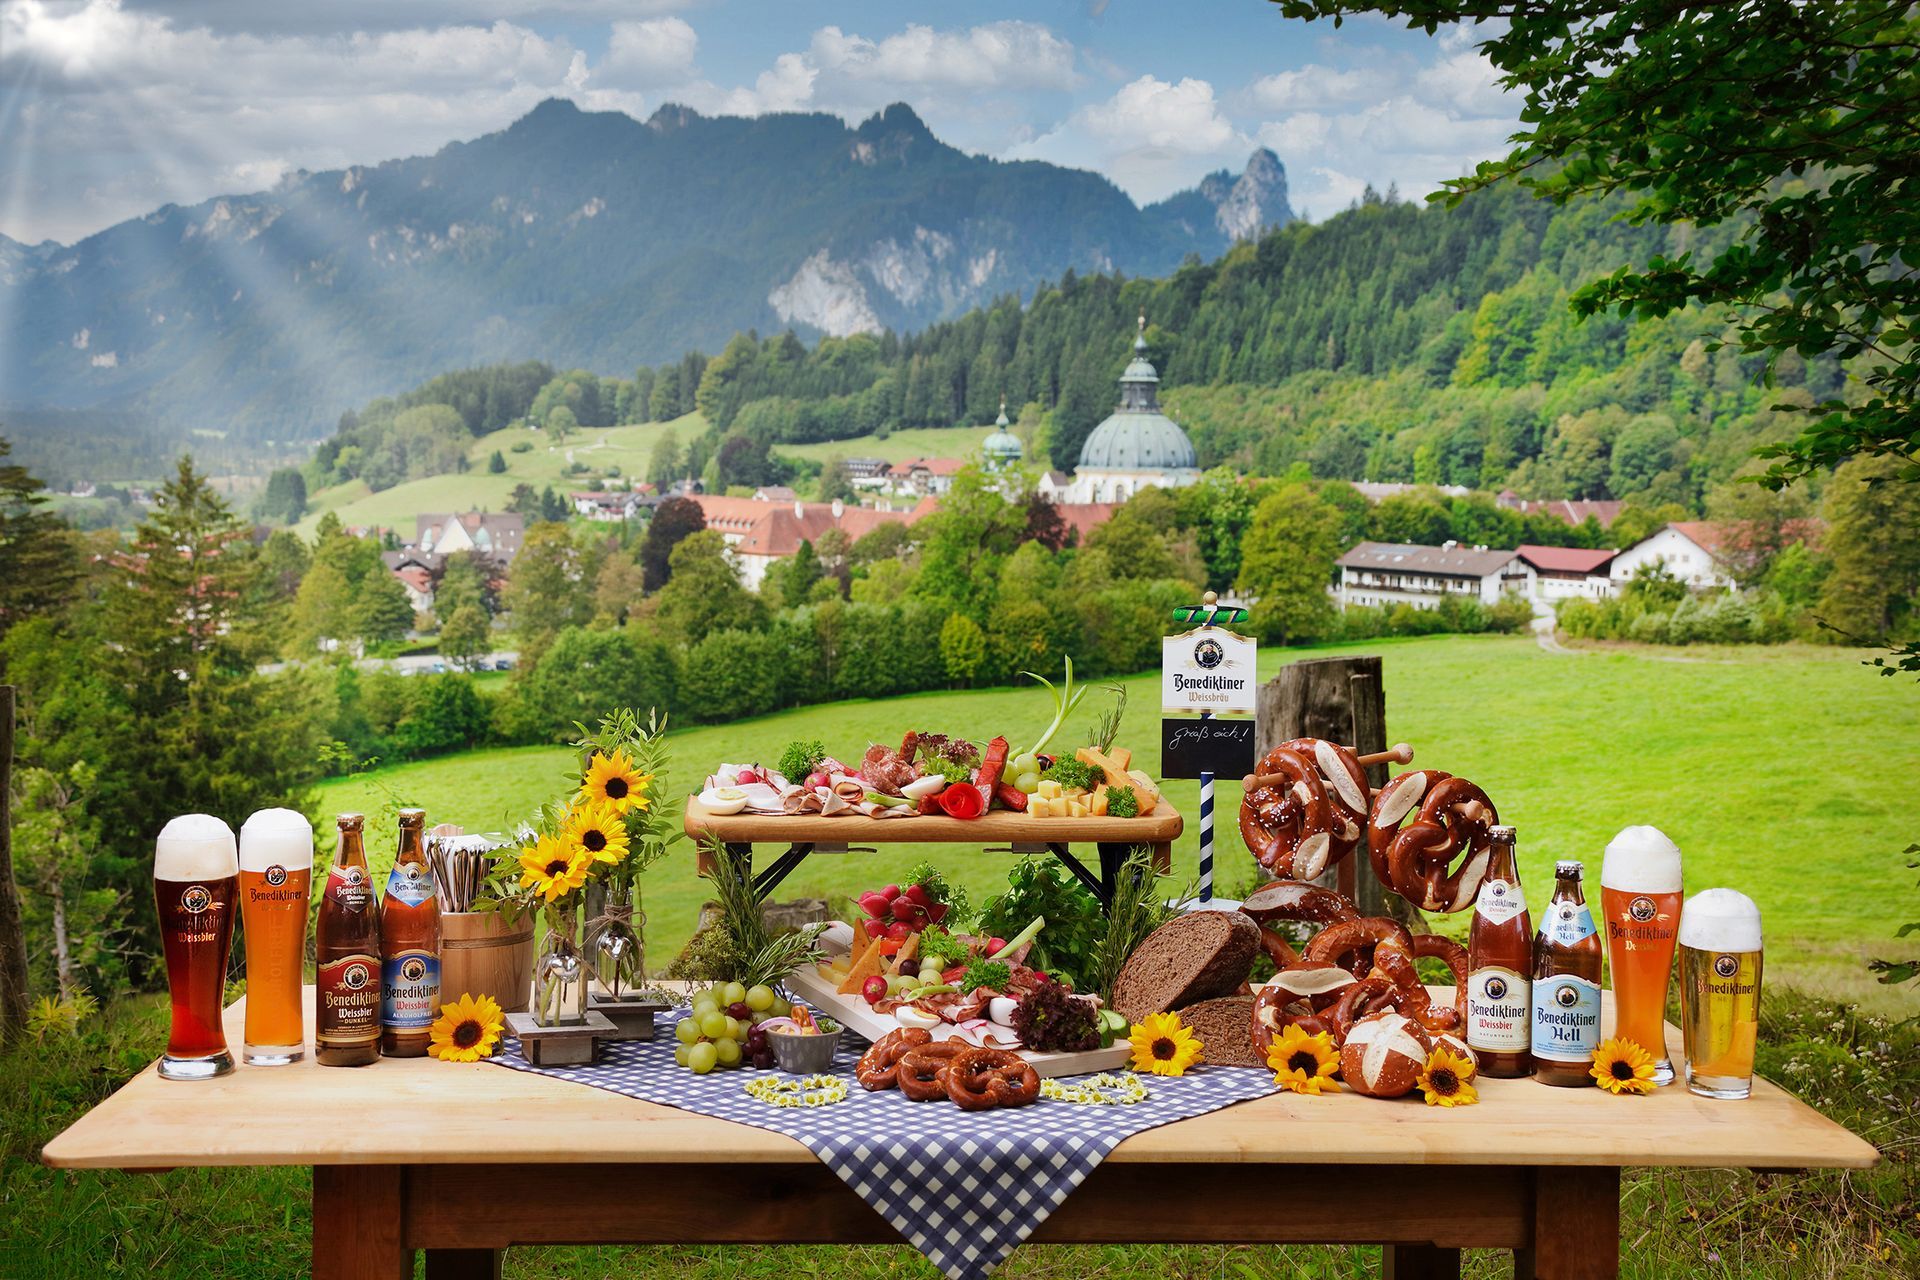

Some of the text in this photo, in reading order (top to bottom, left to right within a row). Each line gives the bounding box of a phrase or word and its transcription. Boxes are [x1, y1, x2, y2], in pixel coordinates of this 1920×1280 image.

[1173, 673, 1245, 692] Benediktiner
[1188, 691, 1229, 703] Weissbräu
[250, 888, 302, 903] Benediktiner
[177, 932, 216, 943] Weissbier
[1609, 921, 1675, 942] Benediktiner
[385, 983, 440, 1000] Benediktiner
[1697, 980, 1754, 997] Benediktiner
[338, 1007, 373, 1019] Weissbier
[396, 1000, 430, 1011] Weissbier
[1470, 999, 1526, 1019] Benediktiner
[1478, 1018, 1513, 1030] Weissbier
[1537, 1007, 1597, 1027] Benediktiner
[1551, 1026, 1580, 1041] Hell
